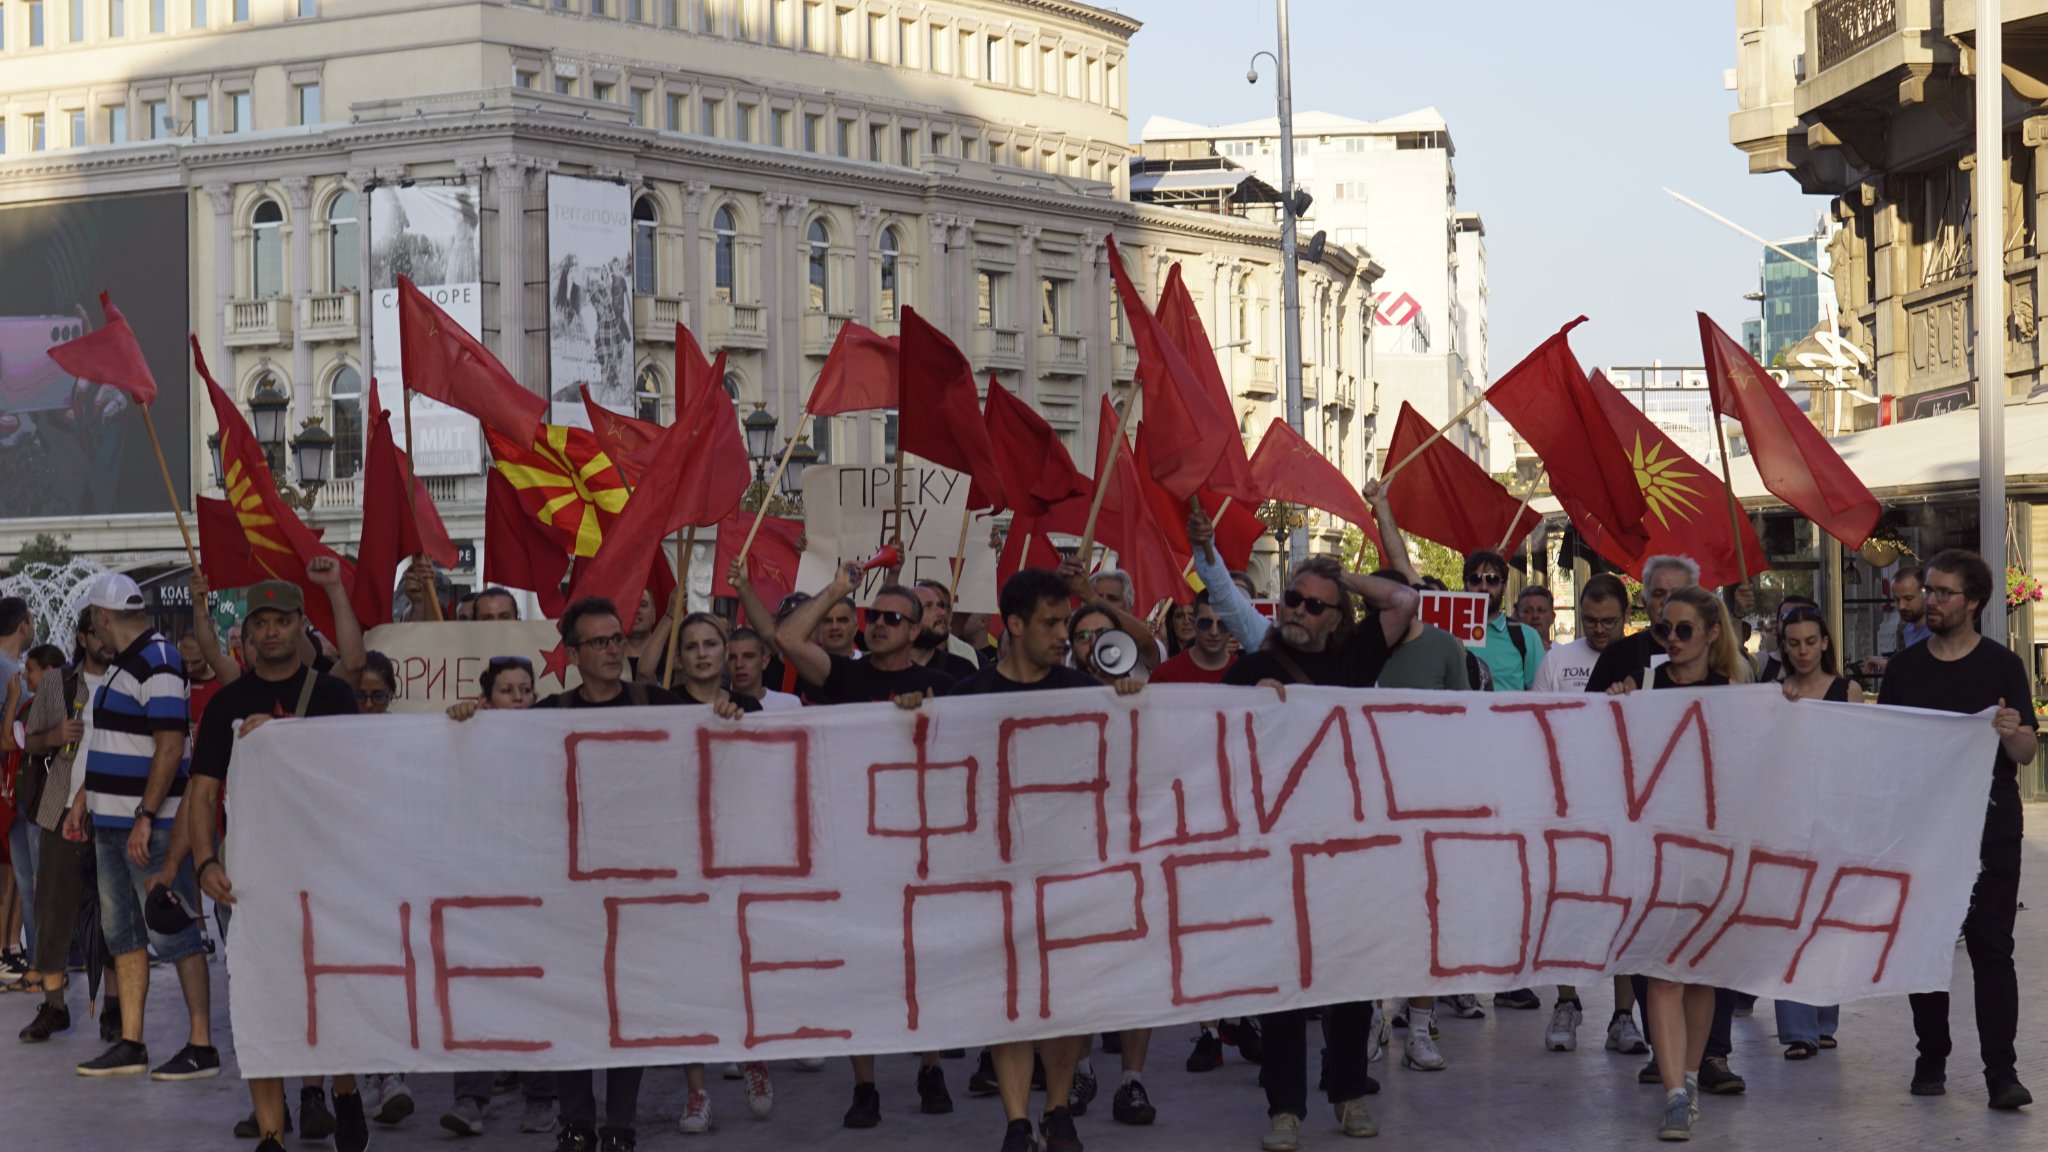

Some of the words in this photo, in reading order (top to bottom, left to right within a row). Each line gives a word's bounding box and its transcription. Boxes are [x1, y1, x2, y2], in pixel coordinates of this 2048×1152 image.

[382, 288, 471, 309] CIOPE
[419, 427, 466, 451] МИТ
[839, 467, 960, 508] ПРЕКУ
[1422, 596, 1486, 641] НЕ!
[564, 725, 815, 881] СО
[868, 699, 1717, 881] ФАШИСТИ
[299, 891, 552, 1052] НЕ
[604, 893, 853, 1049] СЕ
[903, 829, 1912, 1031] ПРЕГОВАРА
